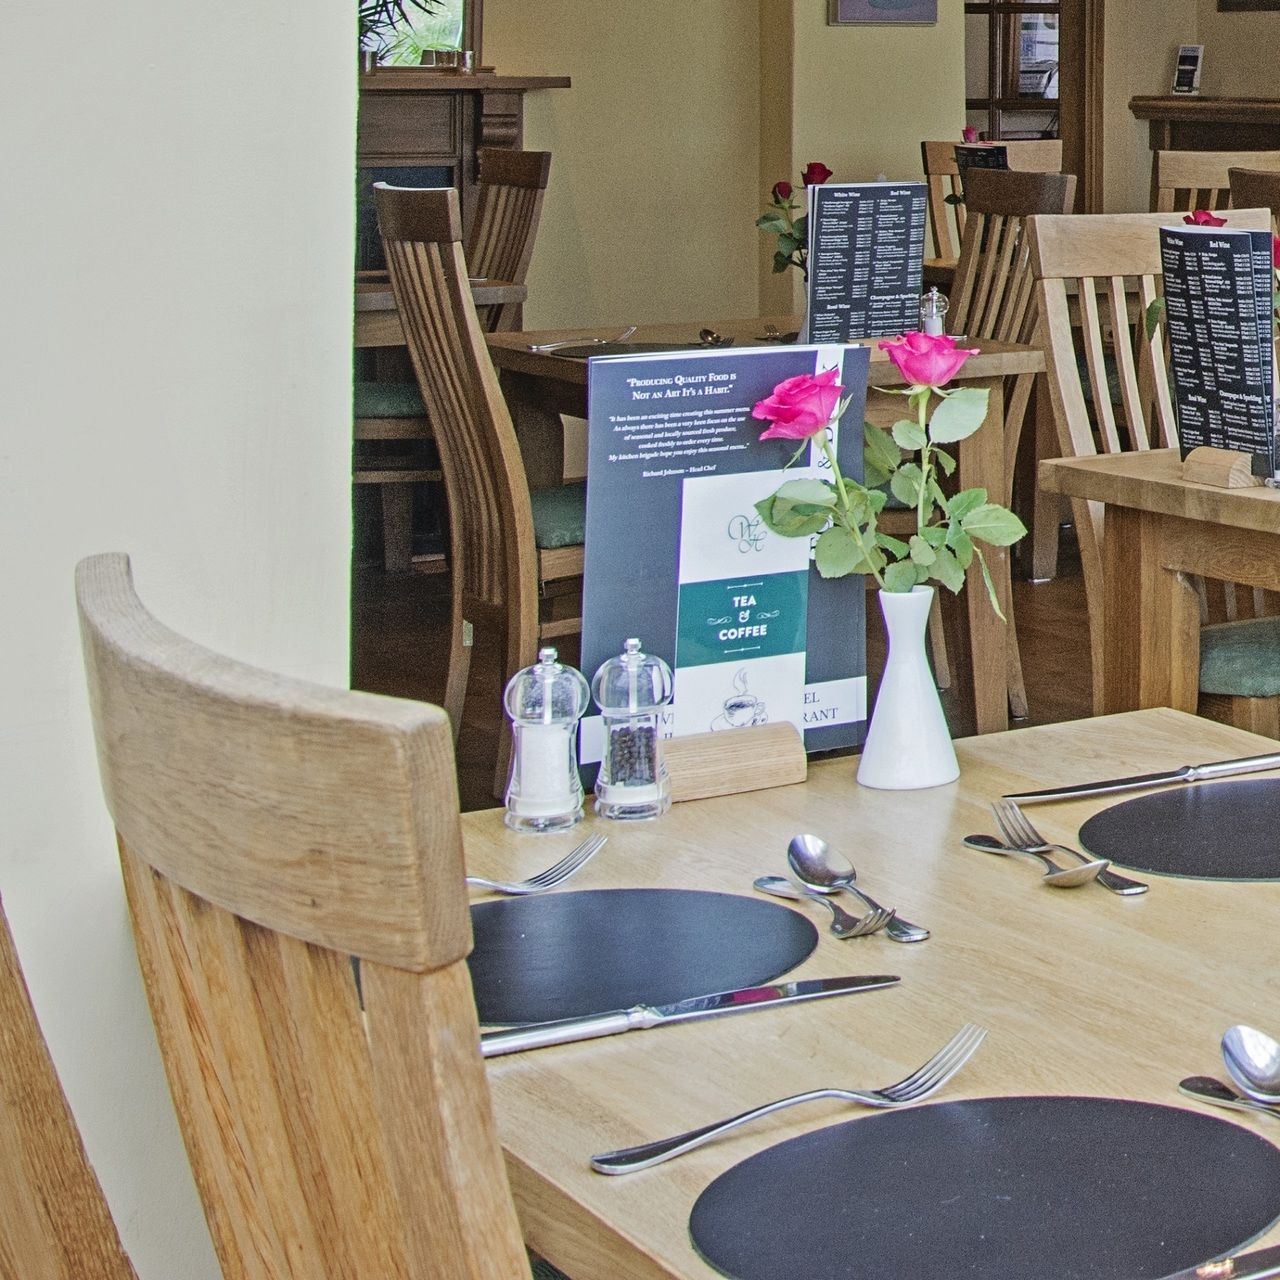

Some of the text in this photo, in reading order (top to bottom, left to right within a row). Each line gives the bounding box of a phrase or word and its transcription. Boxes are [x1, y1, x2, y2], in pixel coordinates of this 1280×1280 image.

[675, 375, 707, 385] QUALITY
[708, 373, 729, 381] FOOD
[632, 390, 650, 400] NOT
[664, 388, 681, 398] ART
[665, 430, 682, 438] locally
[658, 441, 675, 449] freshly
[639, 451, 659, 460] brigade
[733, 595, 757, 607] TEA
[739, 610, 750, 623] &
[719, 625, 768, 641] COFFEE
